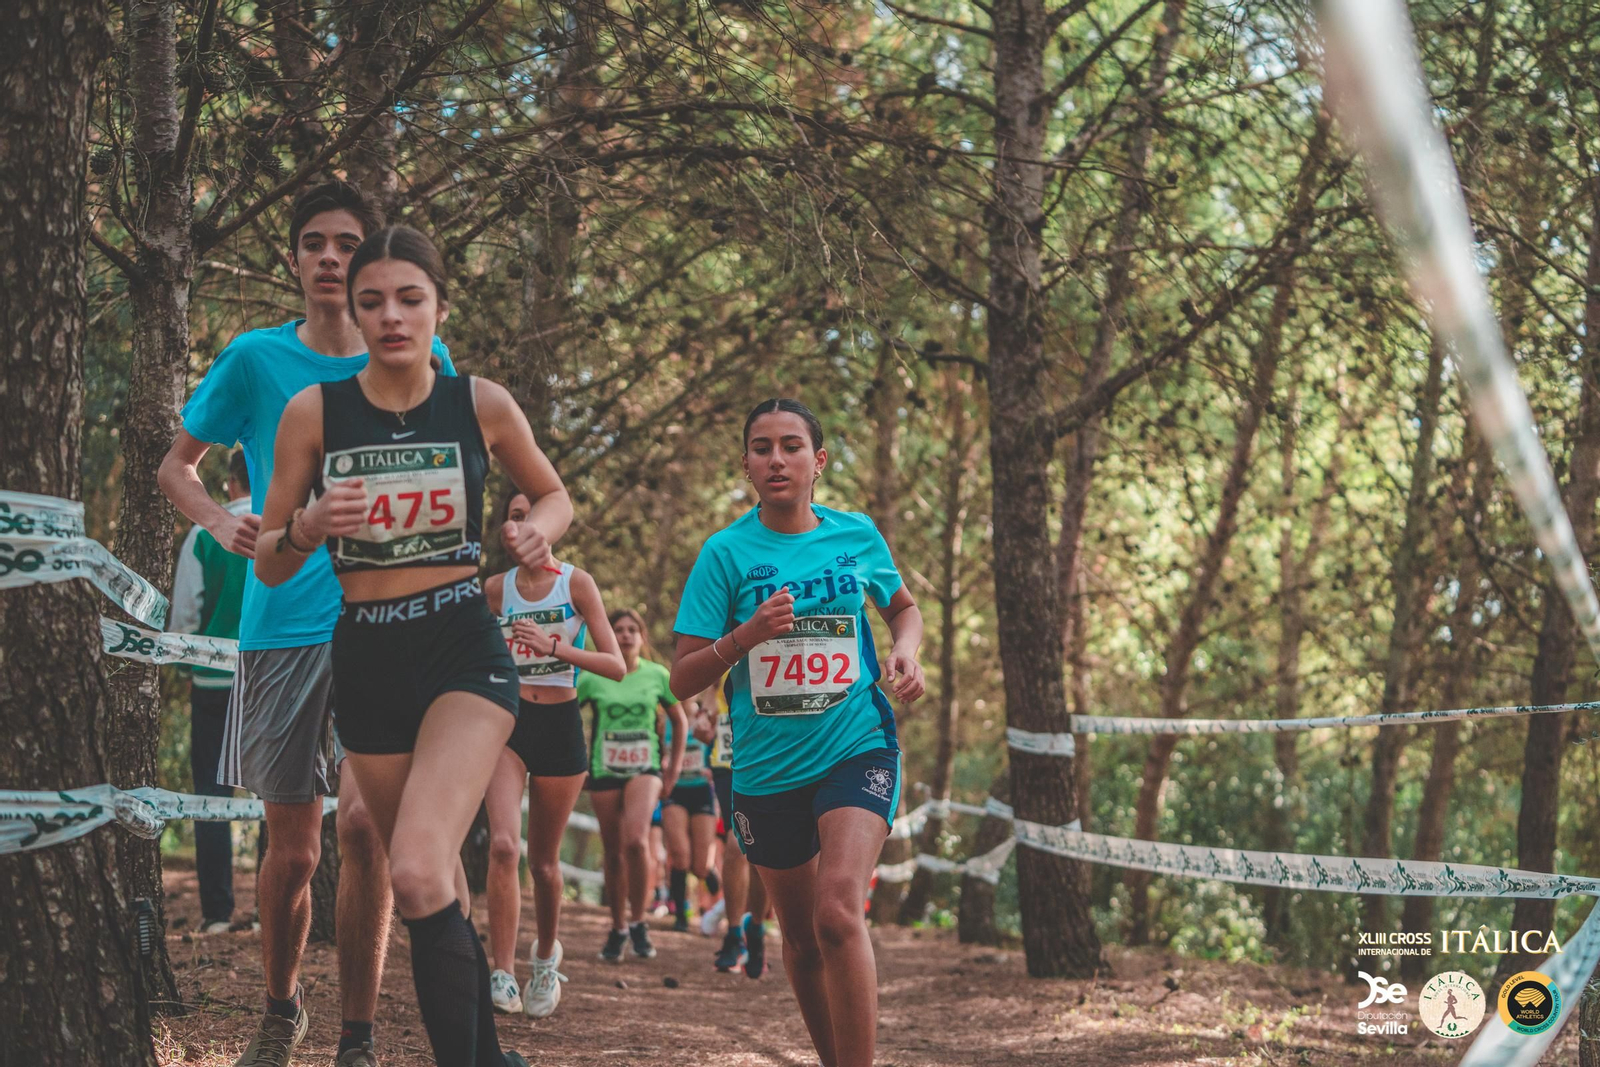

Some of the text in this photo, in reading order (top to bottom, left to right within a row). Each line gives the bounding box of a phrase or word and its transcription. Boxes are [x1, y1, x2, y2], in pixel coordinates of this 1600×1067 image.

[360, 449, 425, 468] ITÁLICA
[368, 489, 456, 530] 475
[748, 566, 778, 578] TROPS
[752, 569, 859, 606] nerja
[356, 596, 428, 624] NIKE
[792, 620, 829, 632] ÁLICA
[505, 633, 562, 658] 74
[760, 652, 853, 688] 7492
[607, 747, 649, 763] 7463
